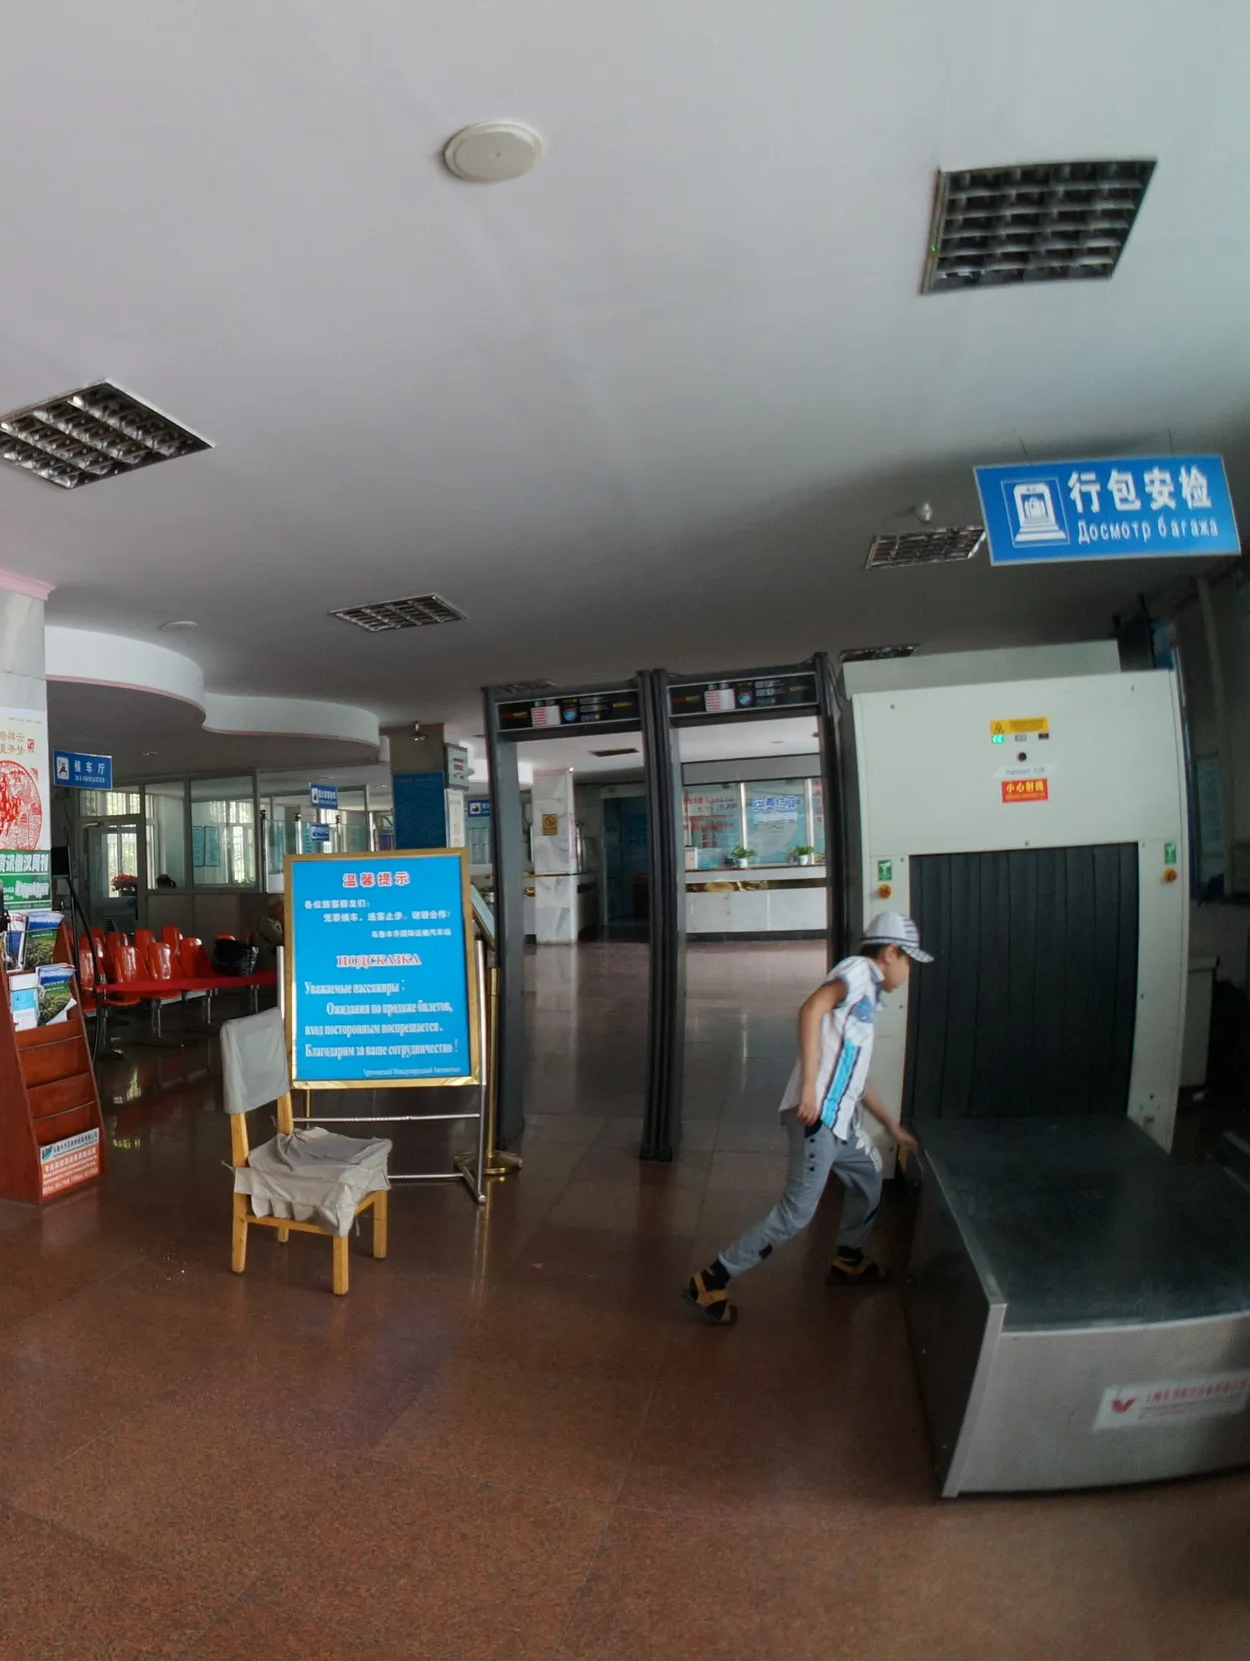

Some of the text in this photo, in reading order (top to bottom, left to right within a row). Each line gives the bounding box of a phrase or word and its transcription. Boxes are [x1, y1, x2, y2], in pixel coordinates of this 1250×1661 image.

[1068, 464, 1212, 513] 行包安检
[1078, 515, 1218, 544] Досмотр багажа
[342, 871, 410, 887] 温馨提示
[336, 952, 422, 969] ПОДСКАЗКА
